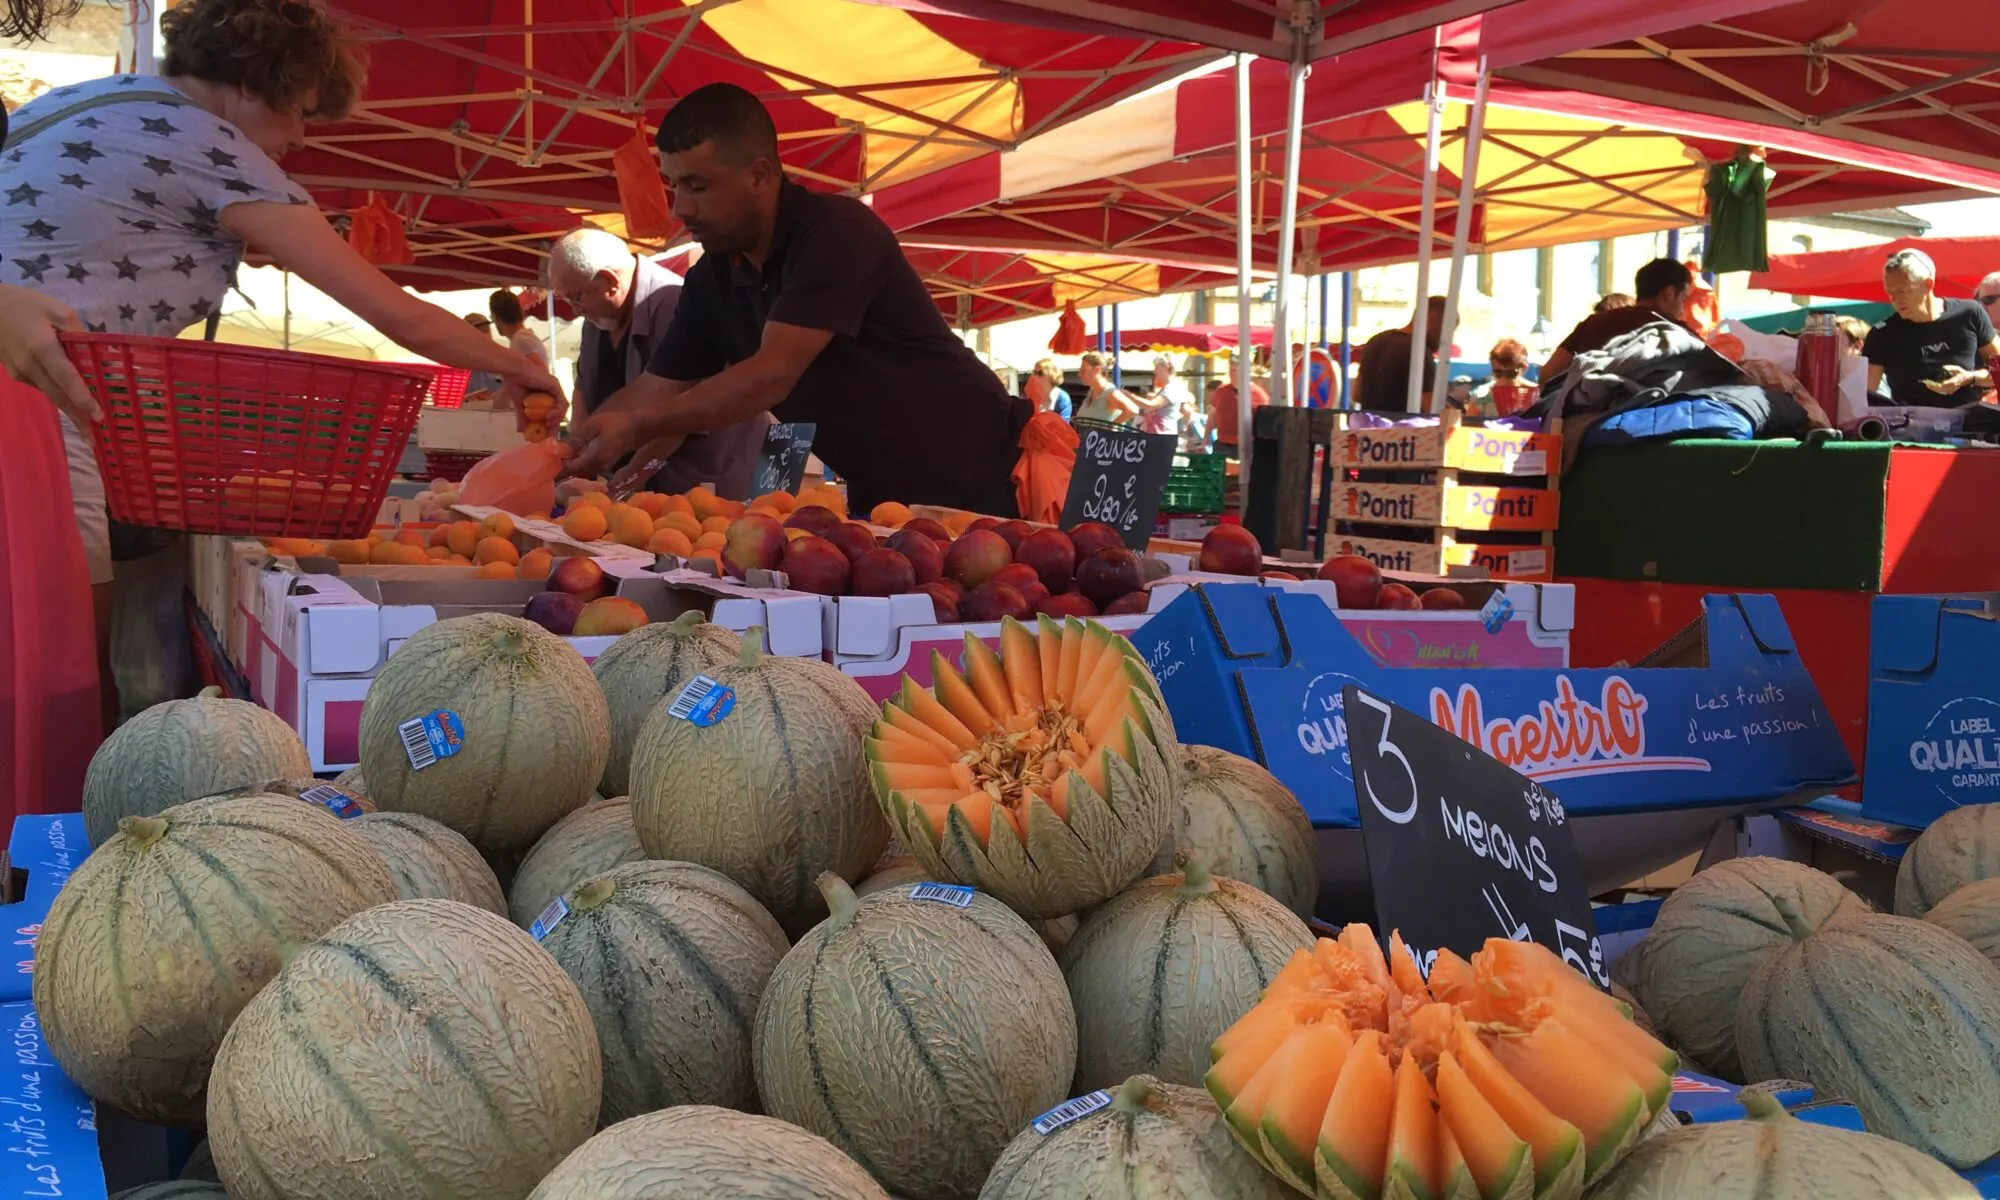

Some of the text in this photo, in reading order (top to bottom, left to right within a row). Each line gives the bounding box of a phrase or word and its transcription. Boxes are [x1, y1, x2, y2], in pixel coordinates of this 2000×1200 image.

[1359, 434, 1416, 462] Ponti
[1360, 488, 1415, 521] Ponti
[1467, 490, 1535, 518] Ponti
[1156, 660, 1185, 685] sion
[1320, 693, 1345, 712] LAB
[1695, 682, 1785, 710] Les fruits
[1297, 714, 1349, 755] QUA
[1688, 718, 1737, 744] d'une
[1742, 714, 1809, 744] passion
[1950, 718, 1996, 734] LABEL
[1357, 690, 1418, 823] 3
[1952, 773, 2000, 788] GARANT
[15, 1011, 55, 1067] passion
[8, 1115, 53, 1158] fruits
[23, 1163, 63, 1197] Les
